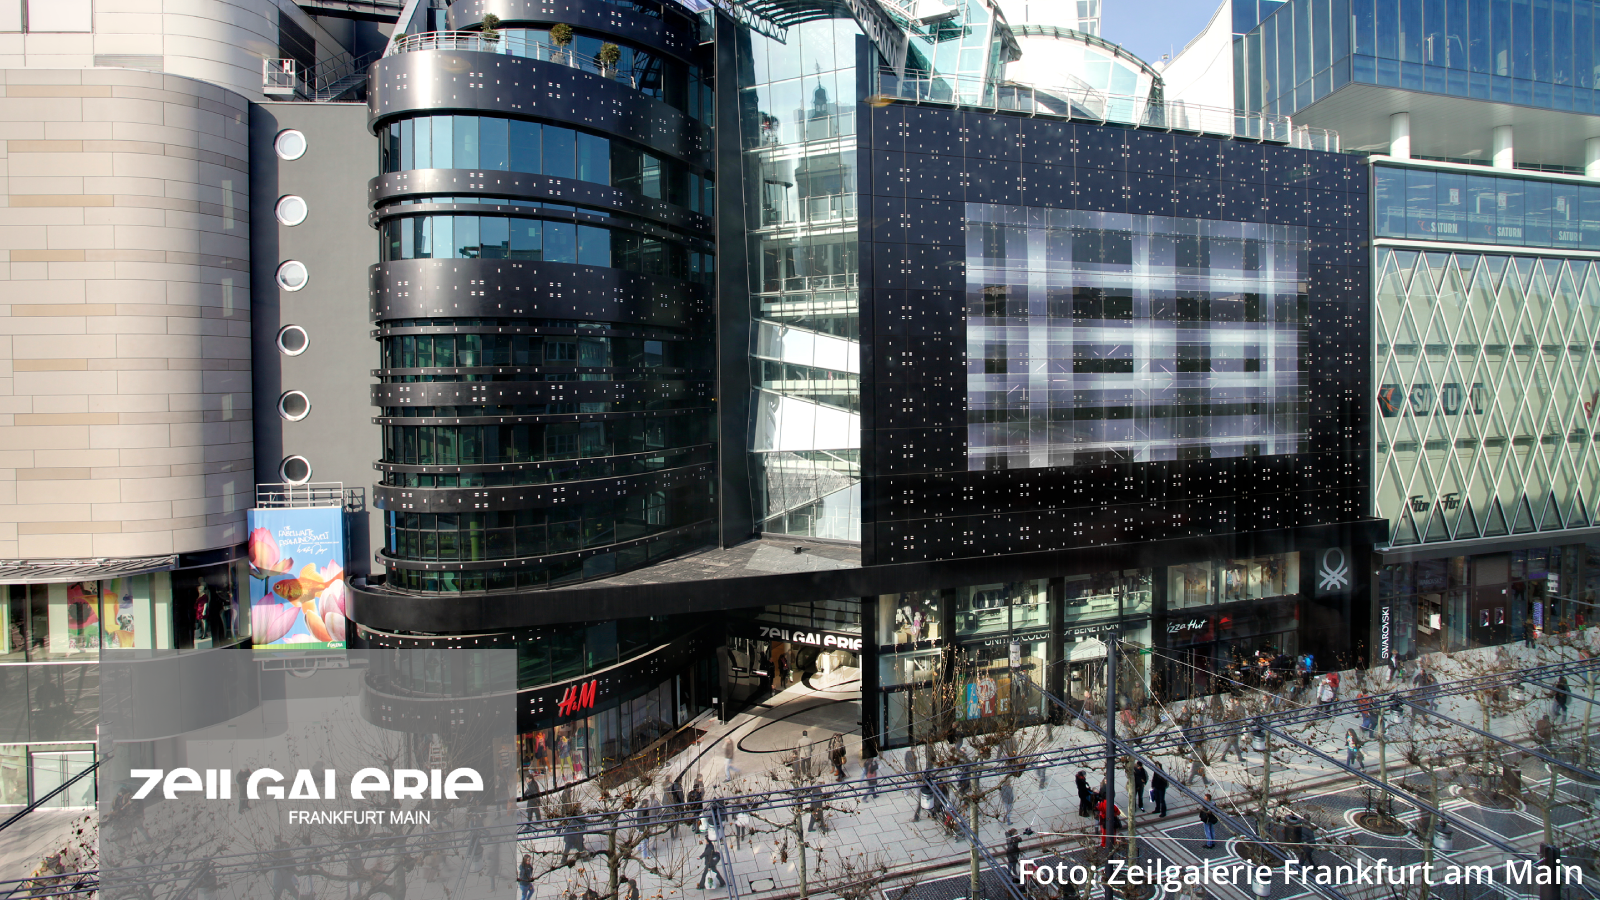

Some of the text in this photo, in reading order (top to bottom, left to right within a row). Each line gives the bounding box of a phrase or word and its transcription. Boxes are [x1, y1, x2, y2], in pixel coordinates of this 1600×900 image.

[1430, 221, 1458, 234] SATURN
[1496, 226, 1522, 238] SATURN
[1558, 230, 1583, 242] SATURN
[1413, 387, 1483, 412] SATUN
[1166, 618, 1208, 634] izza Hut
[1381, 606, 1390, 659] SWAROVSKI
[557, 679, 598, 718] H&M
